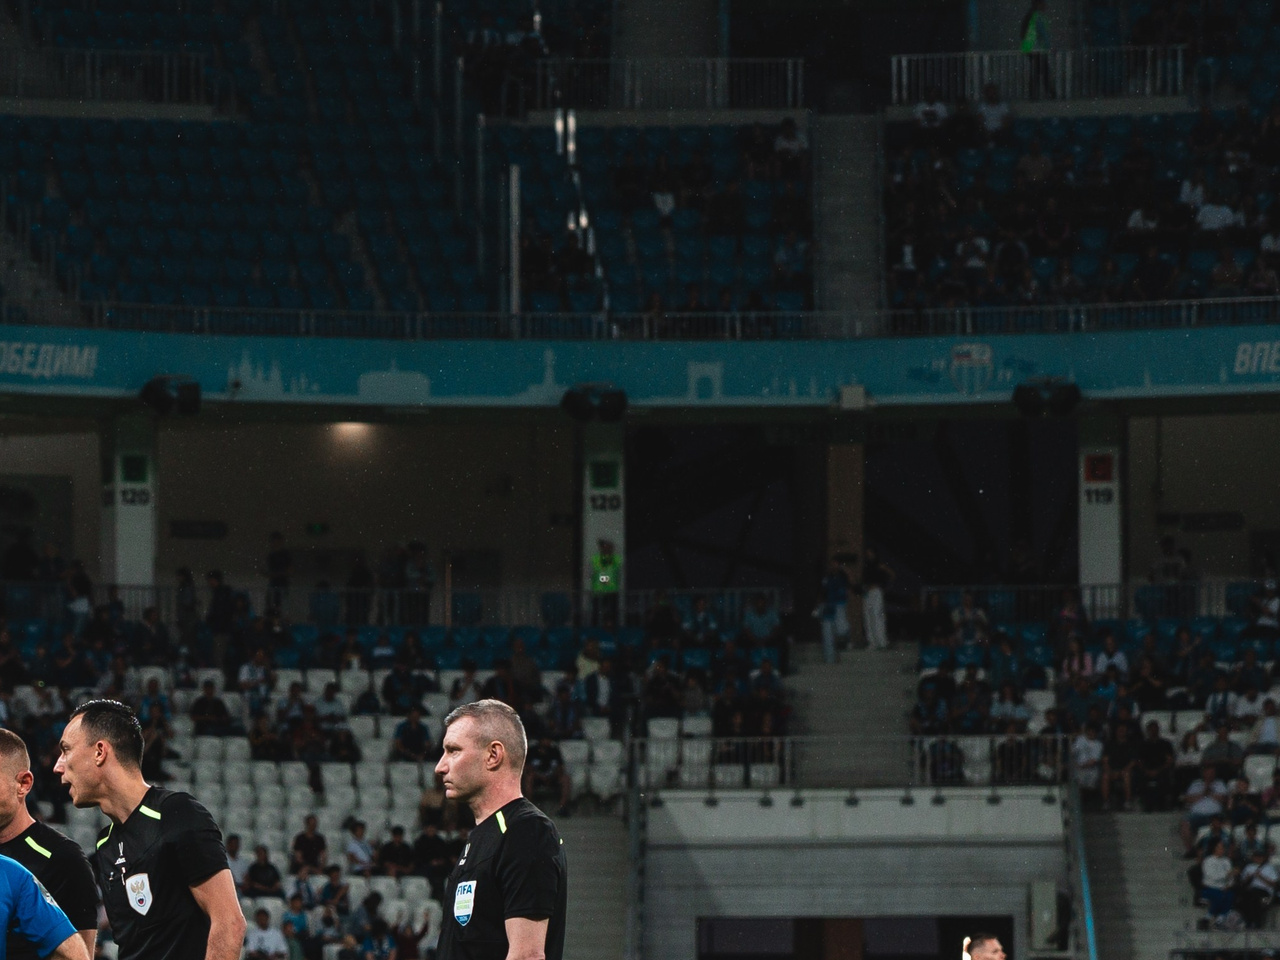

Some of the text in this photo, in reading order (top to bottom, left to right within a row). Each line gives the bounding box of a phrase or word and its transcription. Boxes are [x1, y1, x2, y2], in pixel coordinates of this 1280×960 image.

[121, 489, 150, 505] 120
[590, 495, 620, 511] 120
[1085, 488, 1113, 504] 119
[456, 884, 472, 896] FIFA
